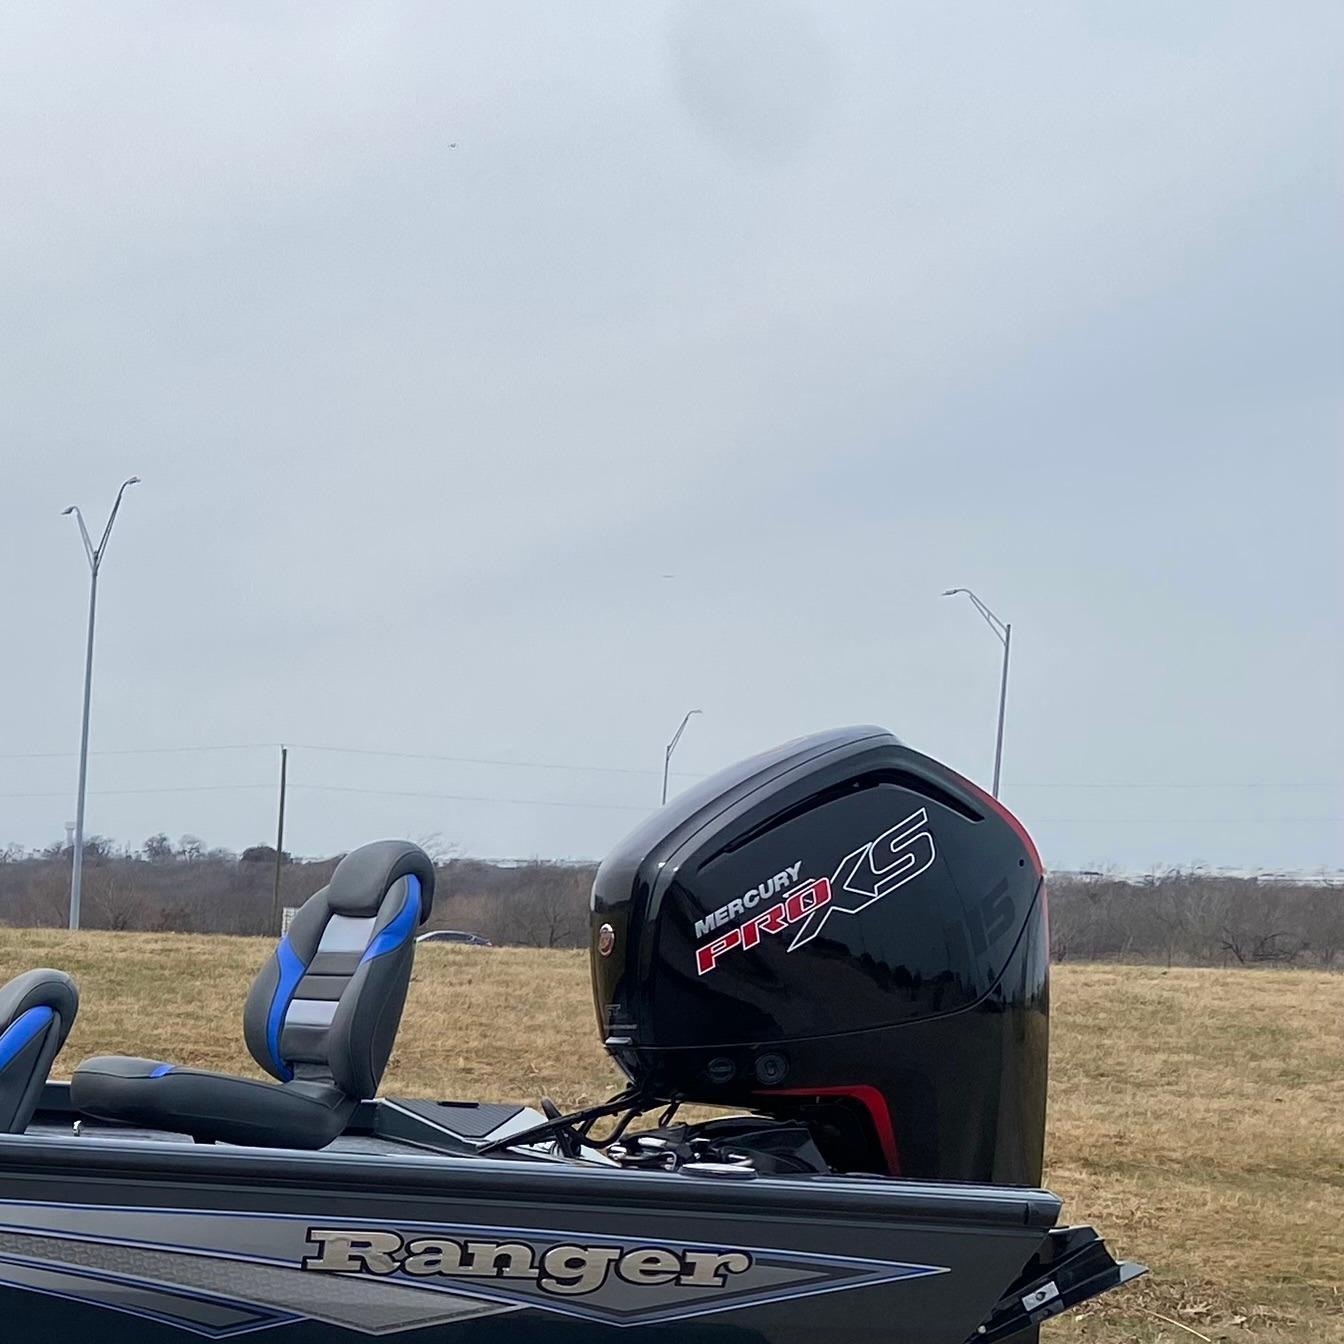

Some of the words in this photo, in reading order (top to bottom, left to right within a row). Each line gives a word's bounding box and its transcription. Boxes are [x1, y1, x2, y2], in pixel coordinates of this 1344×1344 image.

[694, 860, 802, 938] MERCURY
[695, 877, 832, 976] PRO
[302, 1226, 753, 1296] Ranger
